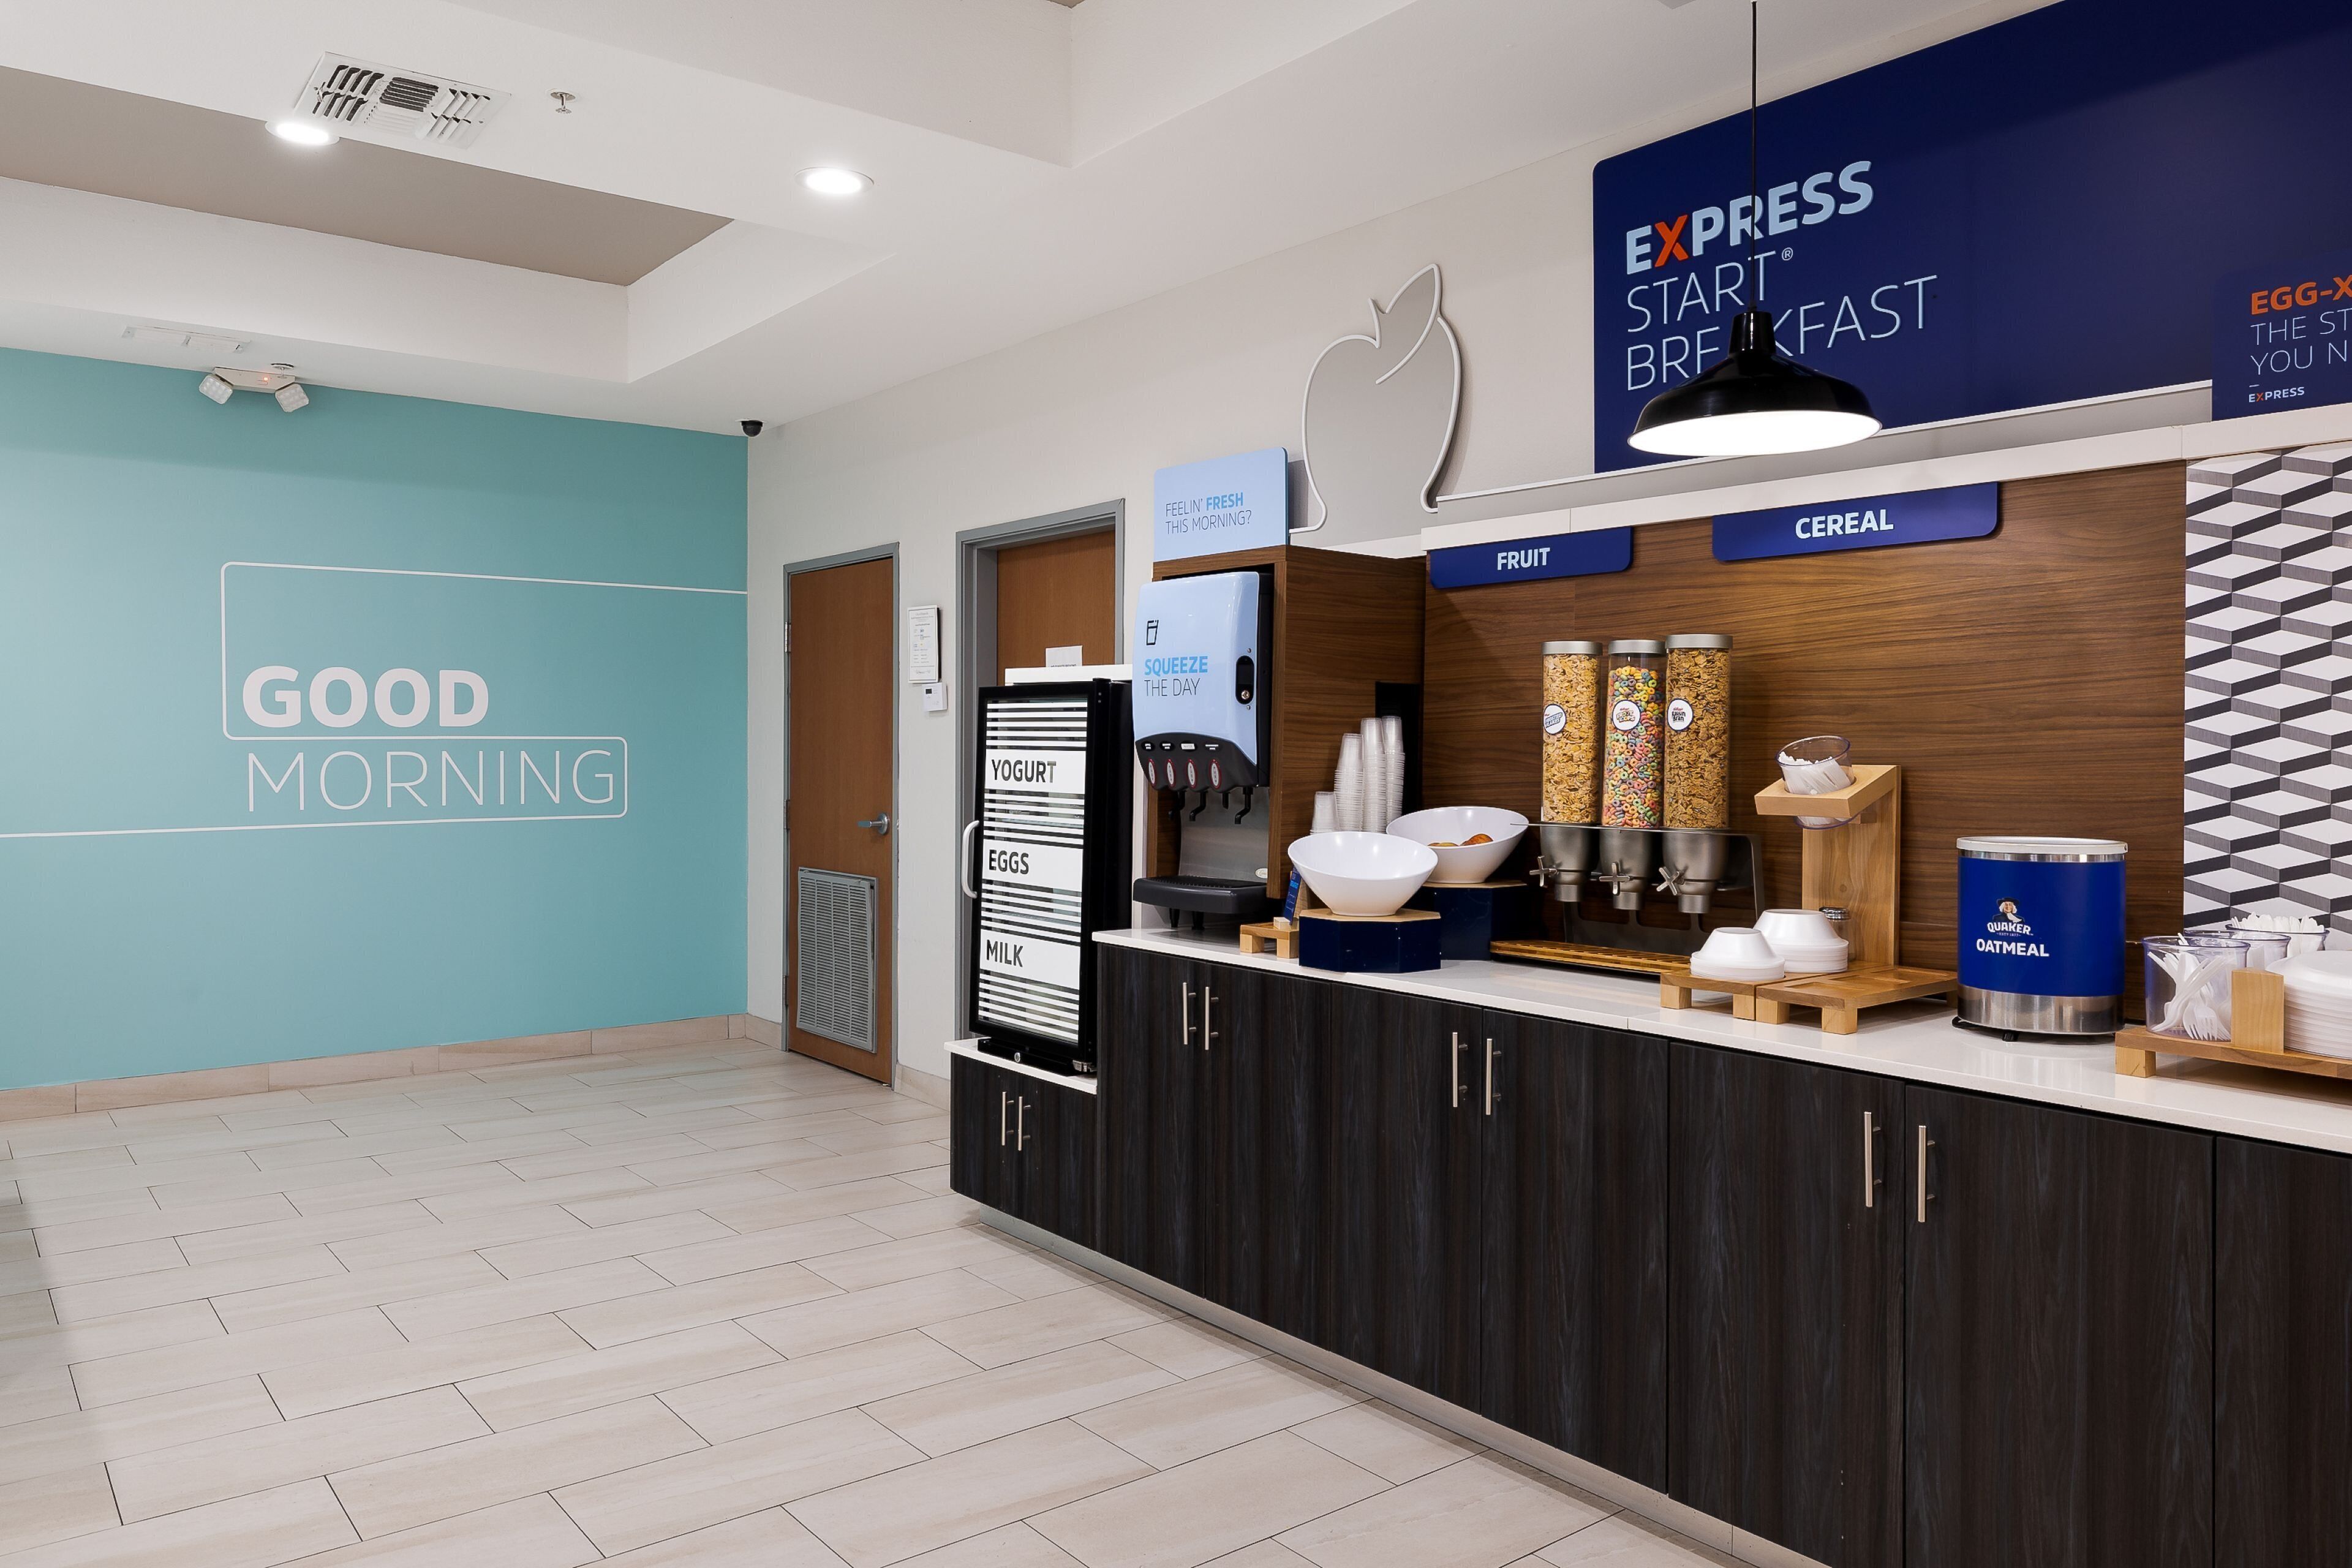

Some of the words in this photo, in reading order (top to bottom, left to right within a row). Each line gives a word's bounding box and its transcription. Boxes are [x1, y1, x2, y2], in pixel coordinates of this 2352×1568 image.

[1627, 160, 1874, 275] EXPRESS
[1627, 275, 1937, 391] BREKFAST
[2250, 316, 2306, 345] THE
[2250, 345, 2313, 375] YOU
[2328, 339, 2347, 364] N
[2248, 386, 2305, 403] EXPRESS
[1205, 492, 1244, 511] FRESH
[1166, 518, 1188, 535] THIS
[1191, 510, 1252, 532] MORNING?
[1795, 508, 1894, 540] CEREAL
[1496, 547, 1551, 571] FRUIT
[1144, 655, 1208, 677] SQUEEZE
[243, 666, 489, 728] GOOD
[1144, 679, 1169, 697] THE
[1173, 677, 1201, 696] DAY
[248, 750, 613, 812] MORNING
[990, 759, 1057, 783] YOGURT
[989, 849, 1030, 875] EGGS
[1987, 922, 2032, 935] QUAKER
[986, 938, 1023, 968] MILK
[1977, 938, 2050, 957] OATMEAL
